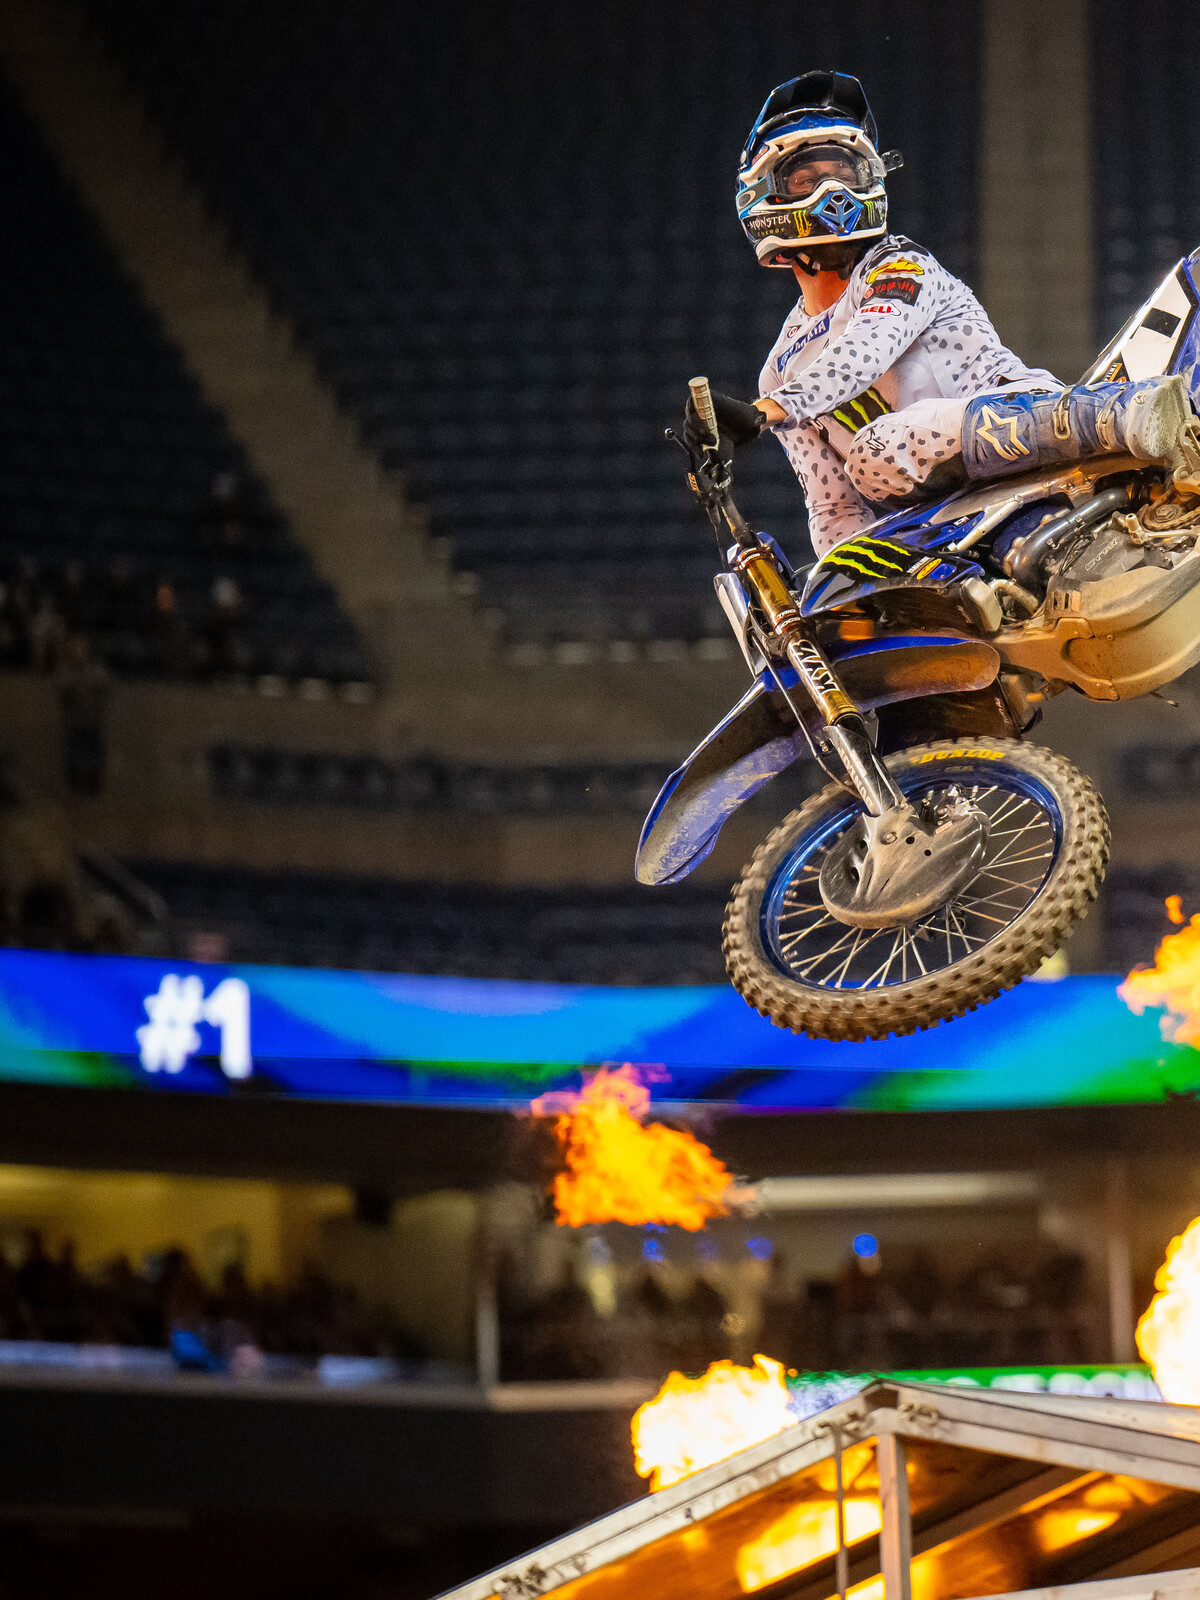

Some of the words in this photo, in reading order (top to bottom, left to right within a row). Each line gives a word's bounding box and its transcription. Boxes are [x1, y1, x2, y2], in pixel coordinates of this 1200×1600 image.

[749, 214, 791, 231] MONSTER
[757, 227, 785, 237] ENERGY
[791, 639, 842, 696] KYB
[920, 749, 1005, 764] DUNLOP
[136, 973, 254, 1079] #1
